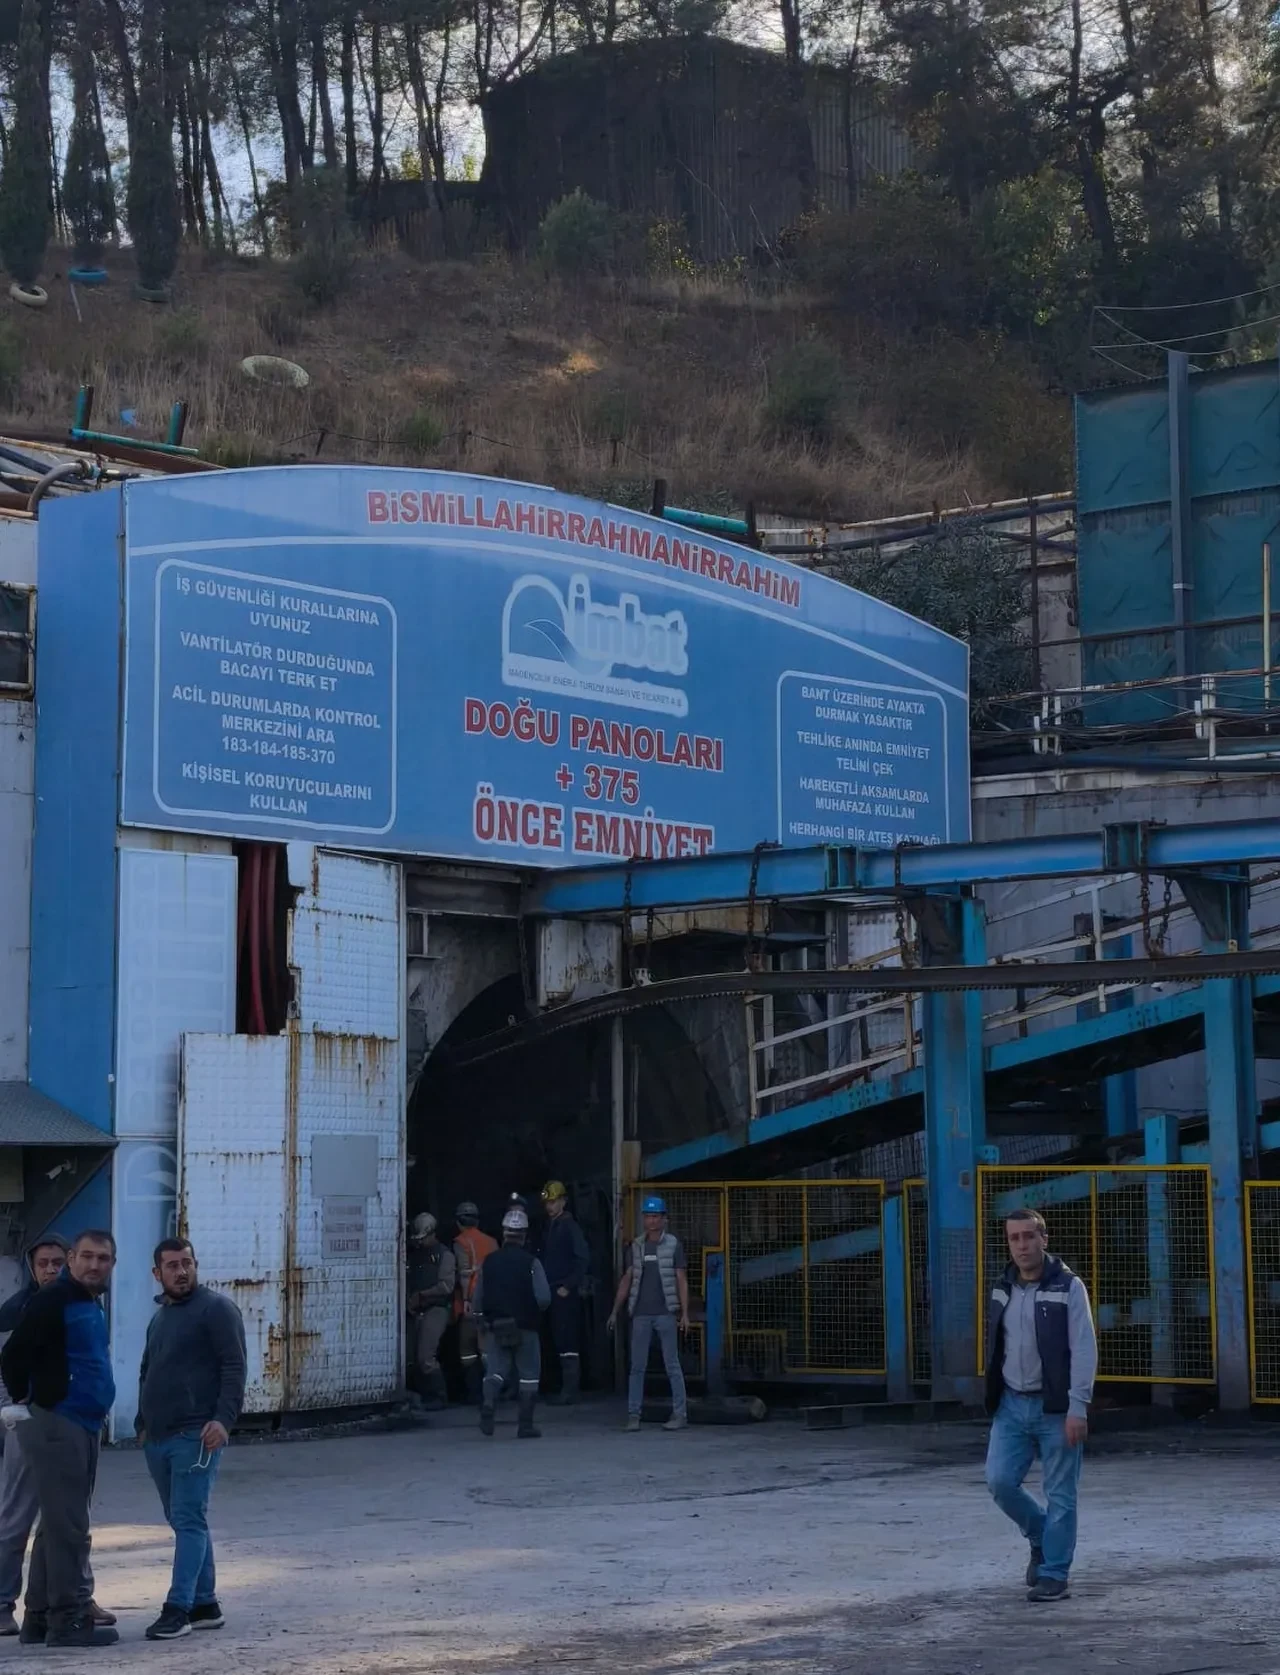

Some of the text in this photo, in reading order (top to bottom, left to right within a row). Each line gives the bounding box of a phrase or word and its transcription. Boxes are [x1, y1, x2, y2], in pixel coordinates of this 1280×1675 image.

[176, 573, 379, 626] İŞ GÜVENLİĞİ KURALLARINA
[250, 611, 311, 634] UYUNUZ
[180, 631, 375, 677] VANTİLATÖR DURDUĞUNDA
[220, 660, 338, 692] BACAYI TERK ET
[172, 684, 381, 729] ACİL DURUMLARDA KONTROL
[801, 685, 925, 715] BANT ÜZERİNDE AYAKTA
[222, 714, 335, 744] MERKEZİNİ ARA
[815, 706, 912, 731] DURMAK YASAKTIR
[464, 697, 724, 772] DOĞU PANOLARI
[797, 731, 931, 760] TEHLİKE ANINDA EMNİYET
[222, 736, 335, 764] 183-184-185-370
[182, 761, 372, 800] KİŞİSEL KORUYUCULARINI
[836, 757, 894, 776] TELİNİ ÇEK
[583, 763, 640, 805] 375
[800, 777, 929, 804] HAREKETLİ AKSAMLARDA
[250, 794, 308, 815] KULLAN
[815, 797, 915, 819] MUHAFAZA KULLAN
[474, 783, 714, 860] ÖNCE EMNİYET
[789, 822, 844, 839] HERHANGİ
[847, 825, 865, 841] BİR
[868, 830, 893, 847] ATEŞ
